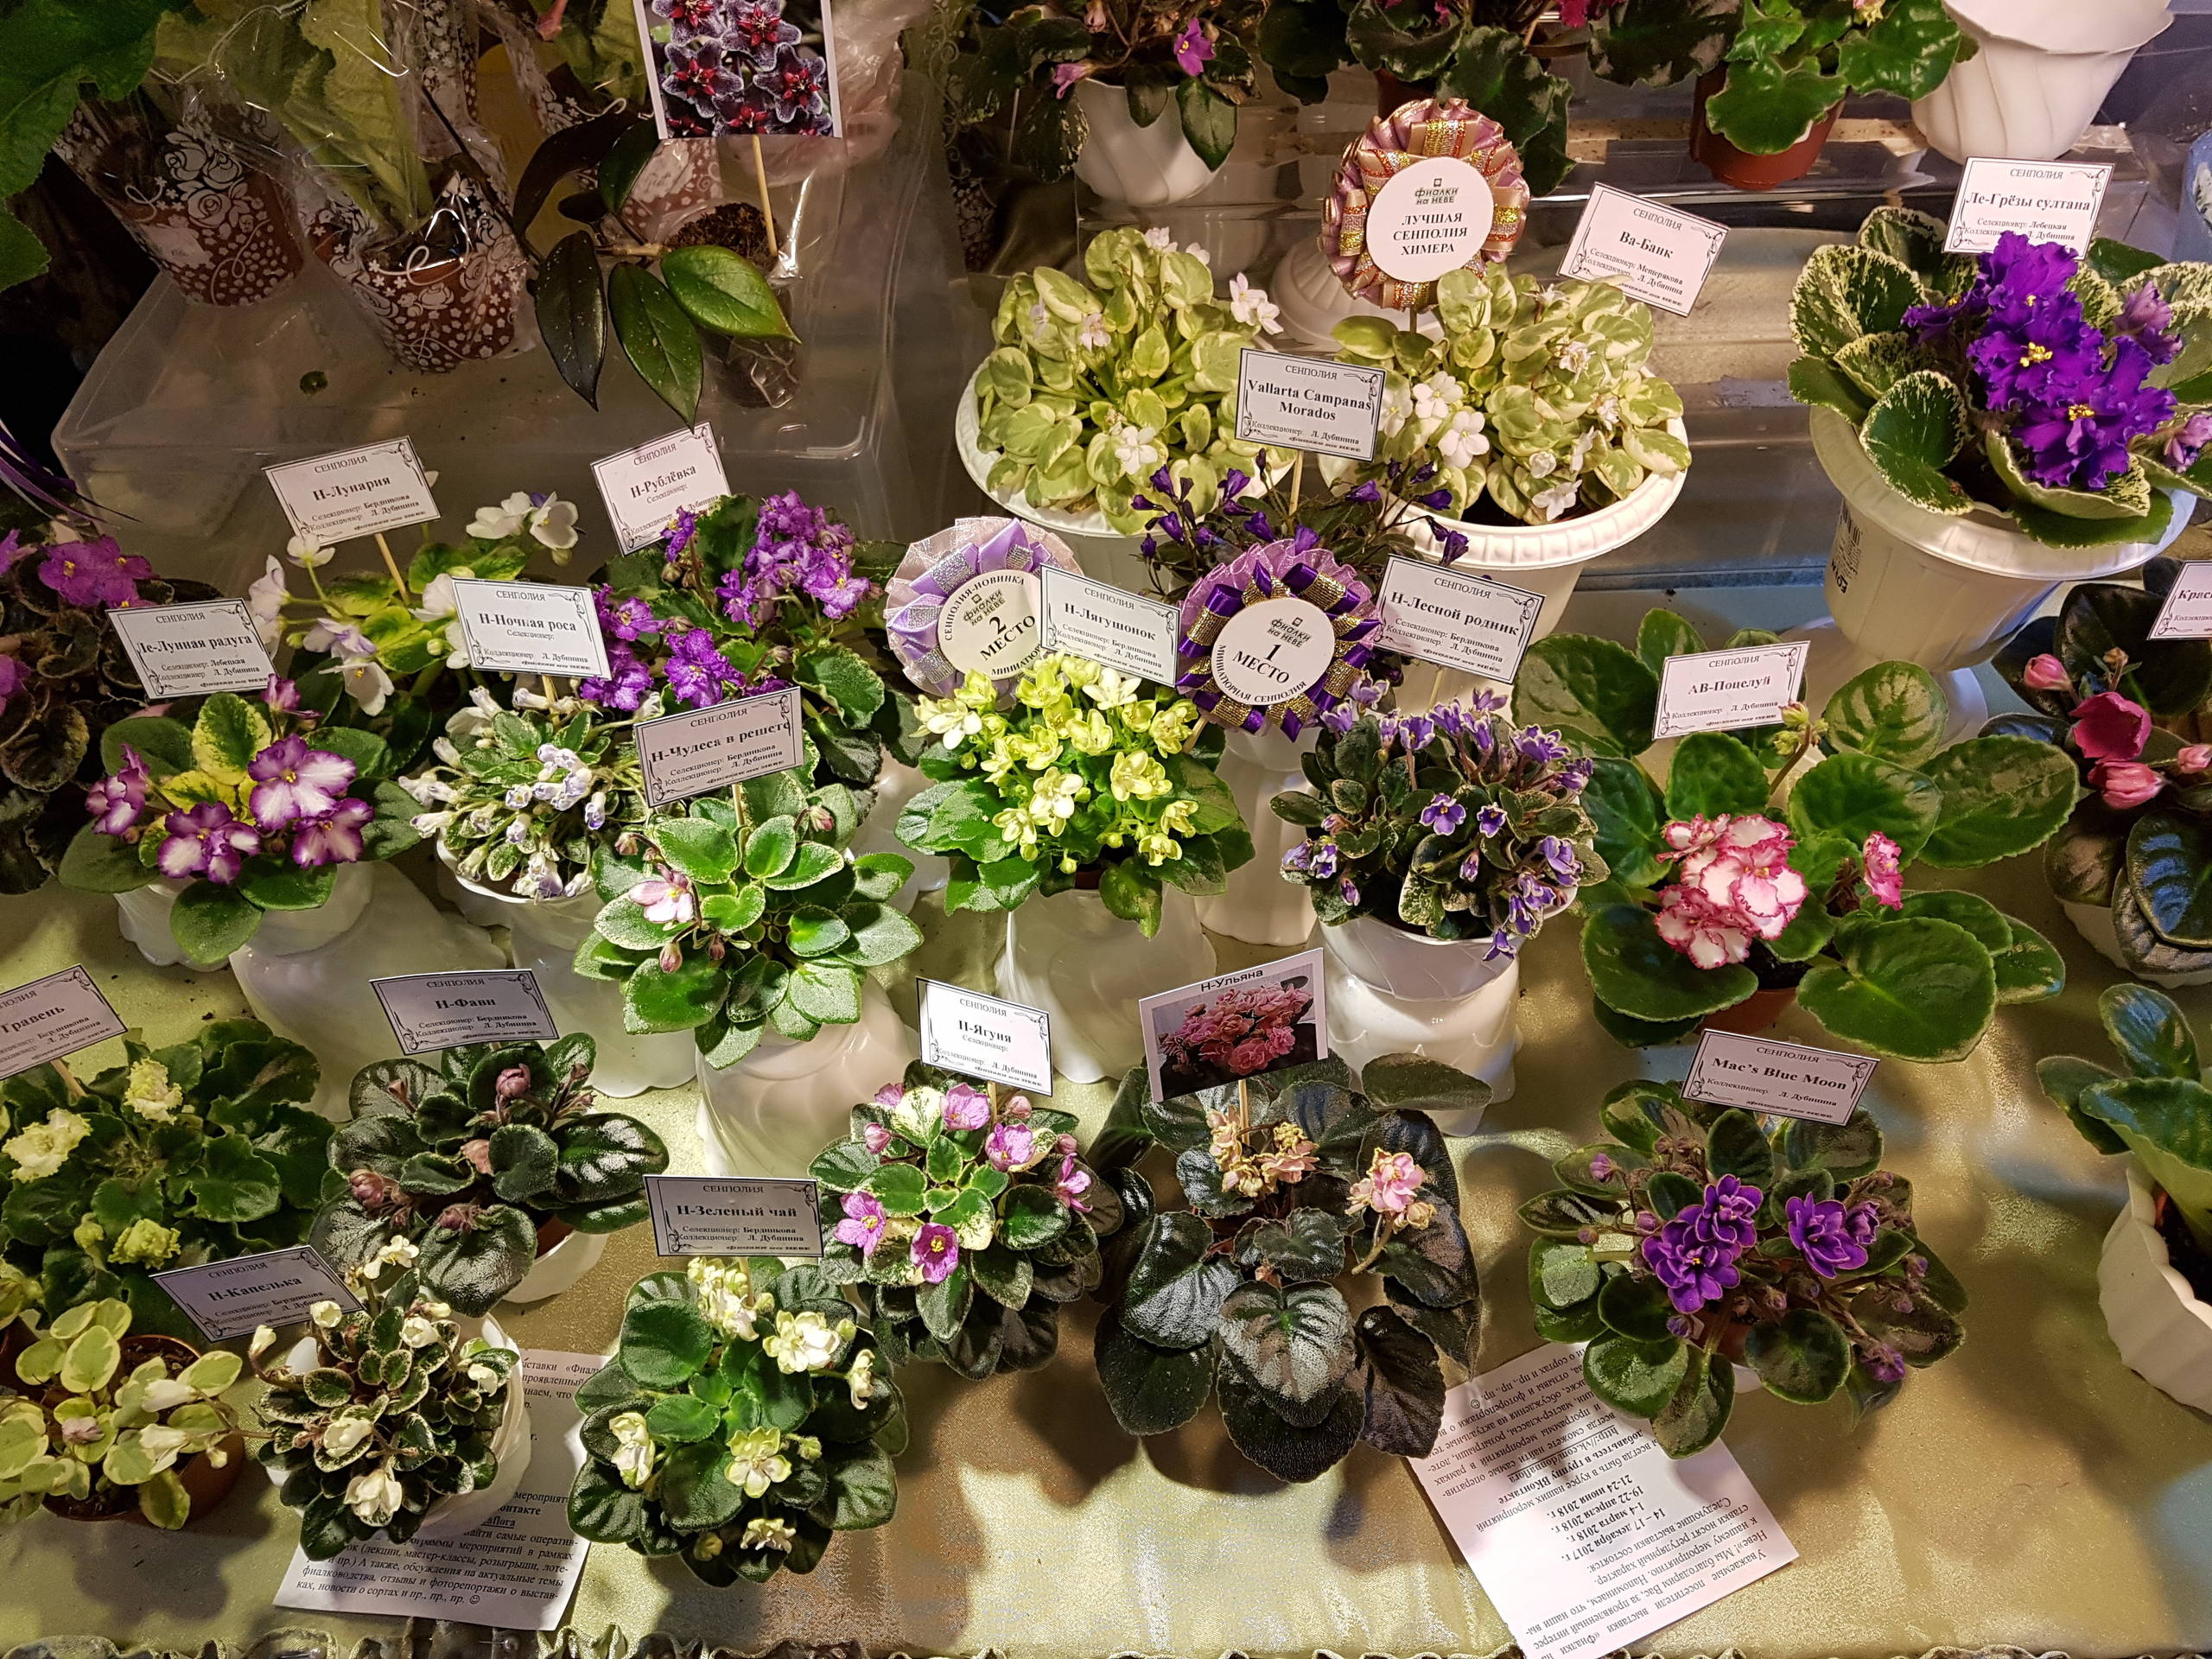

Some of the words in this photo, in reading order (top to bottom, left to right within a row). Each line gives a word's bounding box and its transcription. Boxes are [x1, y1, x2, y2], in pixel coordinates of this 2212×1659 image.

[2010, 168, 2063, 179] СЕНПОЛИЯ
[1414, 187, 1459, 198] фиалки
[1967, 193, 2032, 208] Ле-Грёзы
[2037, 198, 2090, 211] султана
[1402, 213, 1463, 226] ЛУЧШАЯ
[1633, 208, 1682, 232] СЕНПОЛИЯ
[1393, 227, 1468, 241] СЕНПОЛИЯ
[1401, 243, 1454, 256] ХИМЕРА
[1619, 231, 1674, 259] Ва-Банк
[1285, 365, 1338, 380] СЕНПОЛИЯ
[1249, 380, 1299, 398] Vallarta
[1304, 389, 1371, 411] Campanas
[1279, 402, 1336, 421] Morados
[633, 443, 677, 466] СЕНПОЛИЯ
[315, 455, 368, 474] СЕНПОЛИЯ
[313, 477, 391, 501] Н-Лунария
[631, 466, 696, 498] Н-Рублёвка
[496, 591, 545, 601] СЕНПОЛИЯ
[1084, 588, 1135, 609] СЕНПОЛИЯ
[1434, 578, 1491, 600] СЕНПОЛИЯ
[2178, 590, 2212, 602] Крас
[944, 575, 1025, 641] СЕНПОЛИЯ-НОВИНКА
[1390, 592, 1461, 620] Н-Лесной
[1465, 614, 1519, 639] родник
[156, 613, 206, 624] СЕНПОЛИЯ
[479, 613, 545, 629] Н-Ночная
[549, 619, 577, 632] роса
[989, 616, 1007, 636] 2
[1065, 603, 1155, 641] Н-Лягушонок
[138, 641, 207, 655] Ле-Лунная
[208, 635, 253, 651] радуга
[980, 615, 1036, 662] МЕСТО
[991, 643, 1041, 676] МИНИАТЮР
[1263, 644, 1282, 663] 1
[1708, 655, 1760, 668] СЕНПОЛИЯ
[1216, 644, 1251, 701] МИНИАТЮРНАЯ
[1254, 681, 1306, 702] СЕНПОЛИЯ
[1232, 650, 1289, 684] МЕСТО
[1688, 676, 1770, 695] АВ-Поцелуй
[690, 709, 747, 728] СЕНПОЛИЯ
[652, 739, 721, 762] Н-Чудеса
[427, 979, 486, 988] СЕНПОЛИЯ
[1201, 969, 1263, 992] Н-Ульяна
[960, 998, 1007, 1016] СЕНПОЛИЯ
[958, 1020, 1011, 1043] Н-Ягуня
[1757, 1046, 1820, 1064] СЕНПОЛИЯ
[1763, 1068, 1798, 1082] Blue
[1802, 1074, 1847, 1090] Moon
[702, 1185, 764, 1193] СЕНПОЛИЯ
[769, 1207, 797, 1217] чай
[208, 1262, 269, 1280] СЕНПОЛИЯ
[207, 1277, 302, 1302] Н-Капелька
[1592, 1428, 1644, 1459] добавьтесь
[1508, 1425, 1620, 1484] http://vk.com/donnaflora
[1551, 1459, 1585, 1481] группу
[1498, 1476, 1552, 1504] ВКонтакте
[1606, 1474, 1633, 1494] 21-24
[1579, 1487, 1606, 1504] июня
[1618, 1485, 1644, 1504] 19-22
[1547, 1510, 1557, 1519] г.
[1557, 1500, 1580, 1517] 2018
[1583, 1498, 1618, 1519] апреля
[1629, 1502, 1645, 1516] 1-4
[1653, 1508, 1666, 1521] 14
[1561, 1515, 1586, 1532] 2018
[1599, 1510, 1629, 1529] марта
[1634, 1518, 1646, 1531] 17
[1551, 1525, 1561, 1534] г.
[1576, 1524, 1600, 1541] 2018
[1593, 1522, 1632, 1548] декабря
[537, 1550, 573, 1560] рамках
[1573, 1543, 1595, 1560] 2017
[1711, 1548, 1767, 1581] Уважаемые
[296, 1581, 315, 1592] ках,
[318, 1584, 356, 1594] новости
[367, 1588, 398, 1599] сортах
[302, 1566, 376, 1581] фиалководства,
[380, 1576, 415, 1585] отзывы
[429, 1579, 507, 1595] фоторепортажи
[521, 1590, 558, 1600] выстав-
[538, 1577, 564, 1587] темы
[1654, 1580, 1707, 1610] посетители
[1606, 1608, 1649, 1633] выставки
